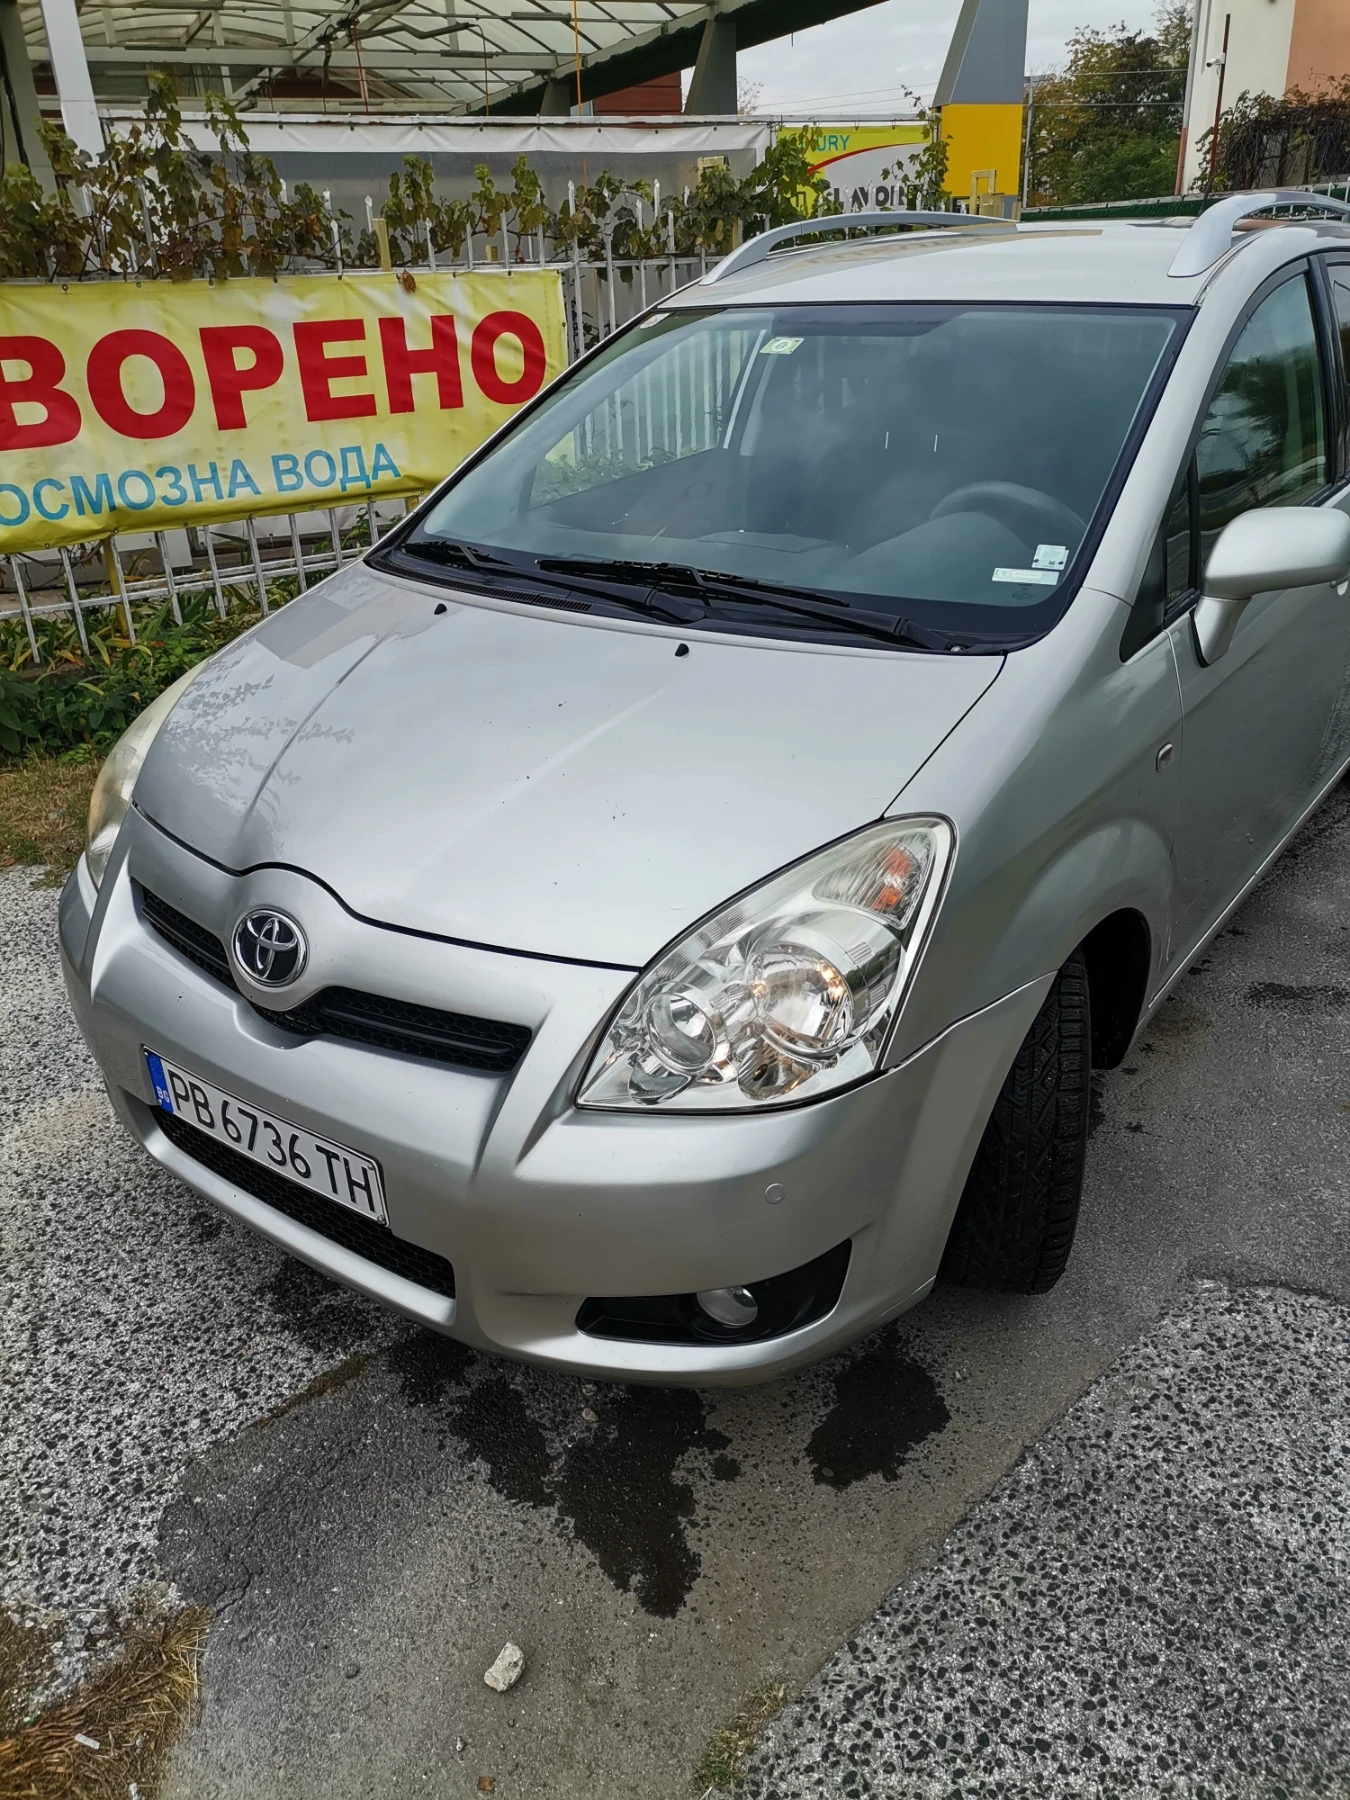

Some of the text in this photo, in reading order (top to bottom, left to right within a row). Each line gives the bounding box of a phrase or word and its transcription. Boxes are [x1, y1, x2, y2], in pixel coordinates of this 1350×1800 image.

[801, 135, 850, 151] URY
[0, 311, 546, 451] ВОРЕНО
[0, 443, 401, 527] ОСМОЗНА ВОДА
[156, 1068, 376, 1213] BG PB 6736 TH
